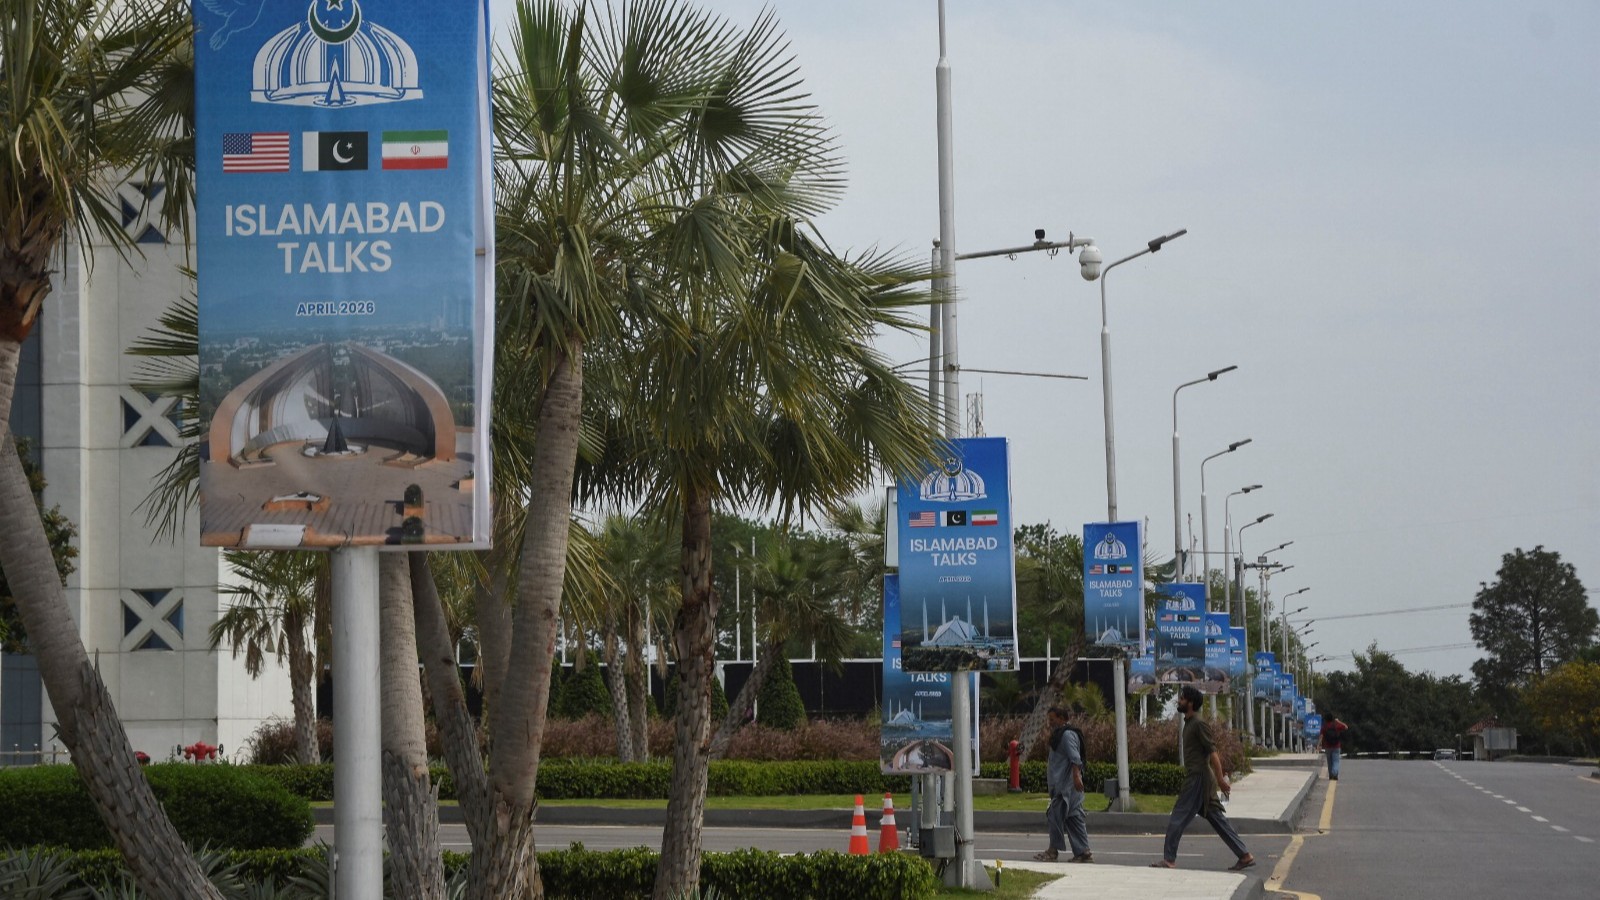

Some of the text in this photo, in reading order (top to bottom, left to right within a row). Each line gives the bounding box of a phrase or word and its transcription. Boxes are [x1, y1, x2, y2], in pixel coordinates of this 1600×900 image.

[225, 201, 446, 236] ISLAMABAD
[277, 240, 392, 273] TALKS
[296, 300, 375, 317] APRIL 2026
[910, 536, 998, 552] ISLAMABAD
[931, 552, 977, 566] TALKS
[1089, 580, 1133, 589] ISLAMABAD
[1100, 589, 1123, 598] TALKS
[1160, 625, 1200, 633] ISLAMABAD
